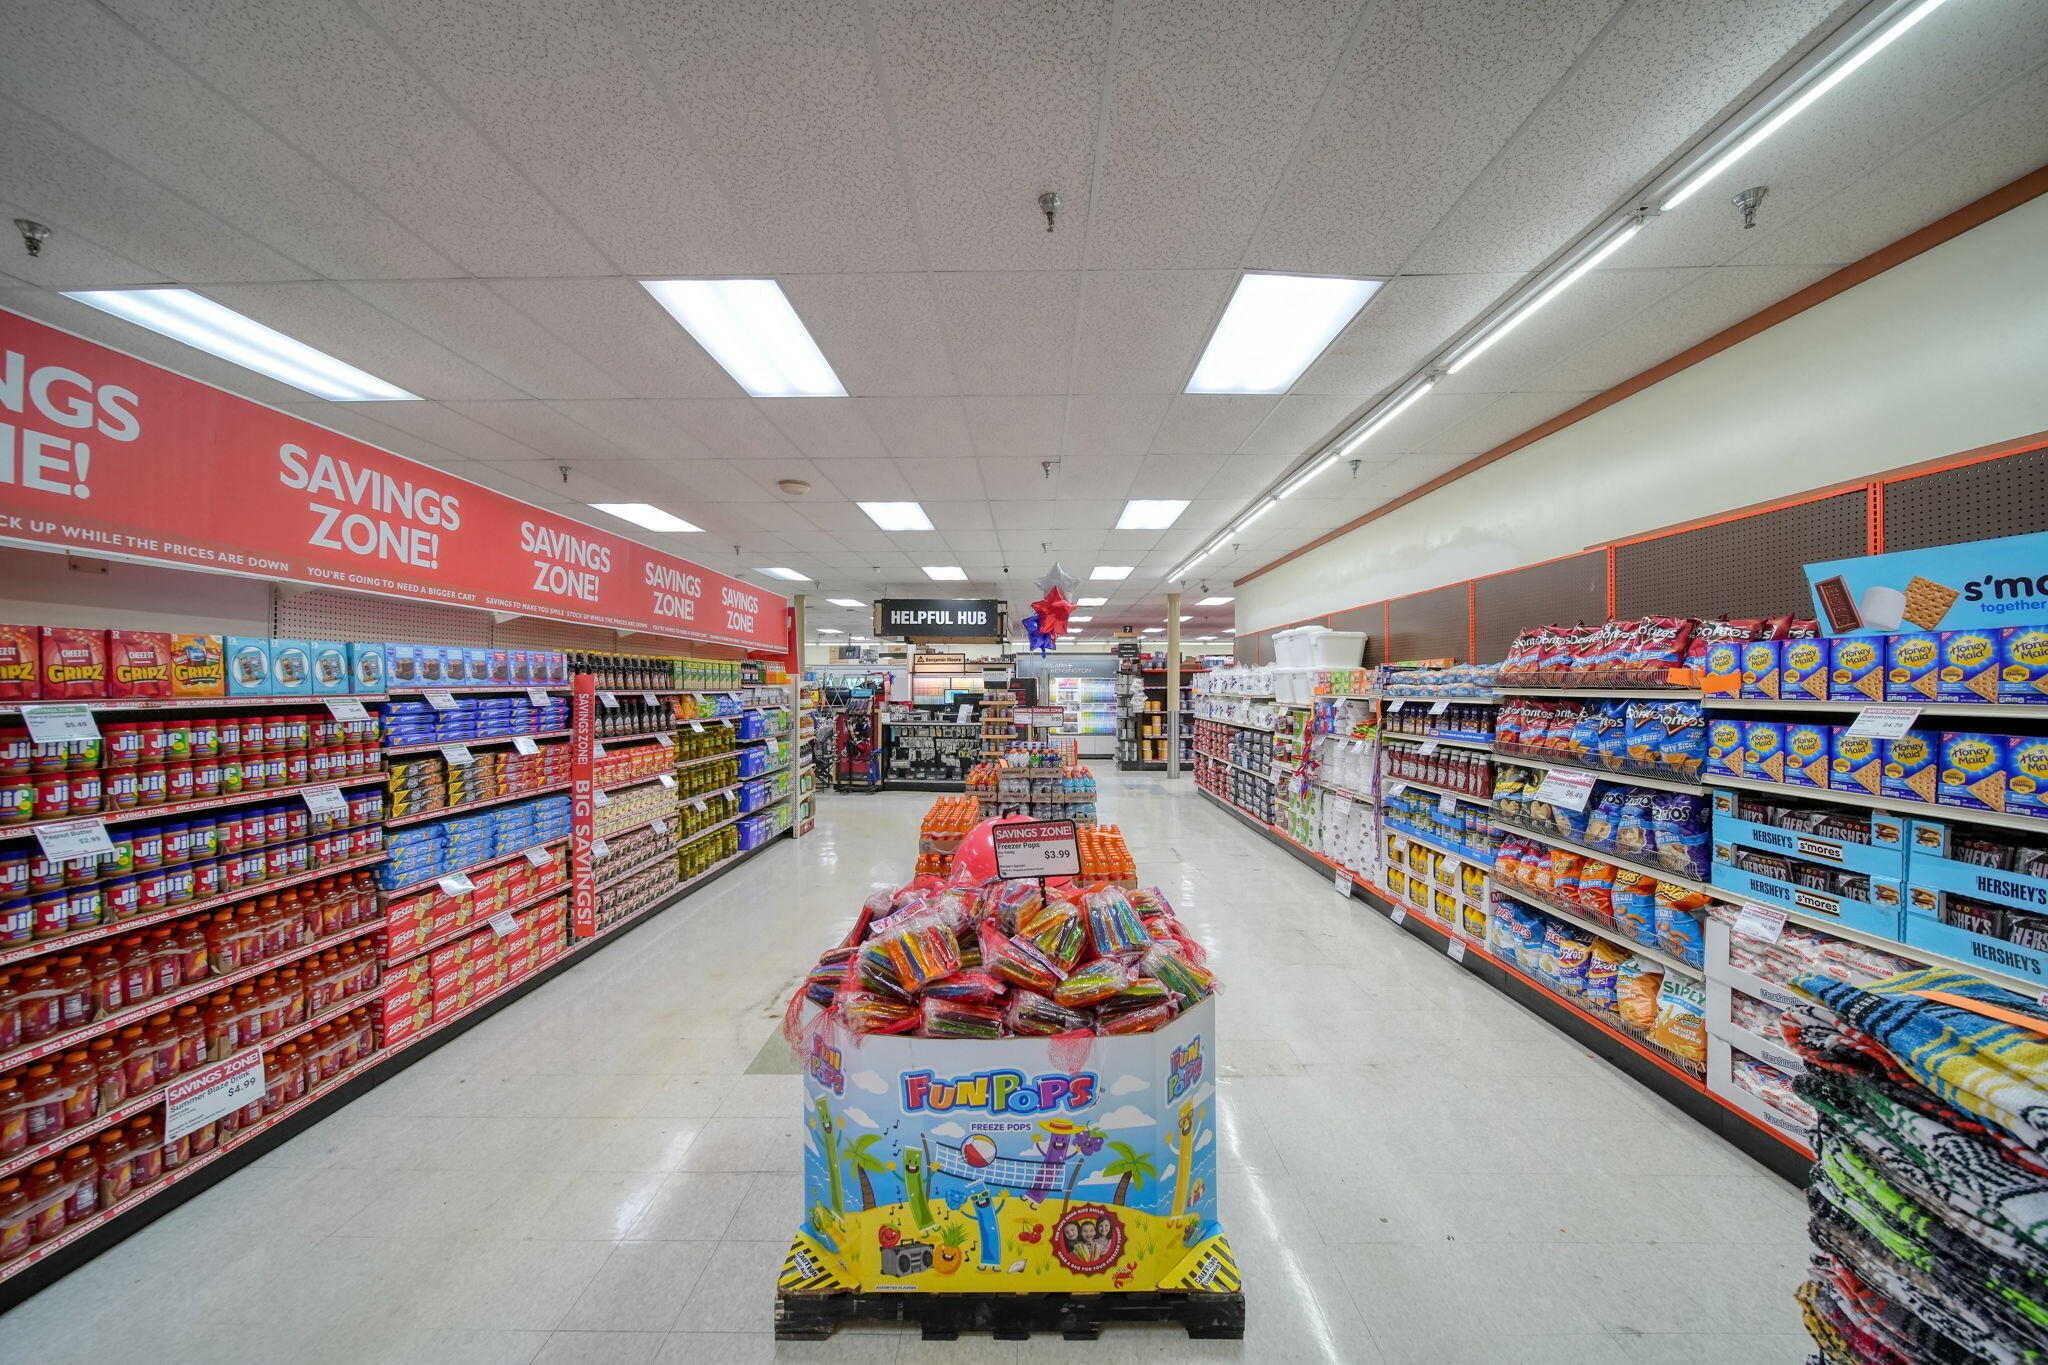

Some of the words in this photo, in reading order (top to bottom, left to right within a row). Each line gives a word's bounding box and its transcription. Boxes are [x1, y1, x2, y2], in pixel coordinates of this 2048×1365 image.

[279, 443, 460, 531] SAVINGS
[308, 502, 439, 570] ZONE!
[30, 519, 57, 535] UP
[61, 525, 122, 546] WHILE
[125, 536, 158, 551] THE
[163, 543, 215, 560] PRICES
[217, 552, 244, 565] ARE
[248, 557, 289, 572] DOWN
[521, 521, 611, 573] SAVINGS
[307, 566, 346, 581] YOU'RE
[349, 574, 381, 587] GOING
[382, 579, 395, 588] TO
[397, 582, 419, 593] NEED
[420, 586, 427, 594] A
[428, 588, 456, 599] BIGGER
[458, 592, 476, 602] CART
[533, 560, 599, 602] ZONE!
[645, 562, 702, 598] SAVINGS
[485, 597, 513, 608] SAVINGS
[513, 601, 521, 609] TO
[522, 603, 538, 612] MAKE
[538, 606, 549, 614] YOU
[550, 607, 564, 616] SMILE
[653, 592, 694, 621] ZONE!
[721, 587, 759, 614] SAVINGS
[1980, 600, 2045, 614] together
[566, 611, 583, 620] STOCK
[727, 610, 754, 633] ZONE!
[890, 610, 953, 625] HELPFUL
[957, 611, 987, 625] HUB
[1790, 649, 1817, 661] Honey
[1898, 645, 1933, 658] Honey
[1950, 641, 1988, 655] Honey
[1956, 650, 1984, 662] Maid
[1712, 653, 1732, 664] Honey
[1714, 659, 1730, 668] Maid
[1794, 656, 1814, 666] Maid
[1903, 652, 1929, 663] Maid
[47, 664, 105, 684] GRIPZ
[117, 665, 169, 684] GRIPZ
[174, 665, 222, 682] GRIPZ
[578, 693, 589, 736] SAVINGS
[1713, 730, 1735, 739] Honey
[1793, 736, 1818, 747] Honey
[578, 735, 588, 764] ZONE!
[1797, 743, 1816, 751] Maid
[1951, 746, 1990, 758] Honey
[1958, 755, 1987, 765] Maid
[575, 780, 590, 816] BIG
[1565, 790, 1584, 799] $6.49
[115, 810, 147, 820] SAVINGS
[42, 831, 69, 840] Peanut
[70, 828, 93, 836] Butter
[996, 828, 1037, 839] SAVINGS
[1040, 826, 1072, 837] ZONE!
[1818, 825, 1871, 845] HERSHEY
[1023, 842, 1040, 850] Pops
[1753, 829, 1793, 849] HERSHEY'S
[1800, 842, 1841, 857] s'mores
[1044, 850, 1070, 859] $3.99
[576, 824, 591, 926] SAVINGS!
[1742, 860, 1787, 881] HERSHEY'S
[475, 876, 493, 891] Zesta
[511, 884, 527, 897] Zesta
[1977, 876, 2047, 905] HERSHEY'S
[1750, 879, 1790, 901] HERSHEY'S
[1797, 894, 1838, 912] s'mores
[389, 904, 414, 923] Zesta
[474, 897, 494, 913] Zesta
[434, 911, 457, 929] Zesta
[44, 940, 63, 950] BIG
[392, 929, 415, 948] Zesta
[433, 949, 455, 967] Zesta
[1972, 941, 2042, 975] HERSHEY'S
[1668, 1028, 1702, 1044] CHEDDAR
[1673, 1024, 1697, 1036] WHITE
[42, 1039, 62, 1052] BIG
[813, 1033, 842, 1070] FUN
[1171, 1038, 1200, 1073] FUN
[169, 1070, 222, 1101] SAVINGS
[224, 1052, 259, 1074] ZONE!
[1168, 1060, 1203, 1103] POPS
[170, 1093, 205, 1113] Summer
[207, 1081, 229, 1095] Blaze
[230, 1070, 251, 1084] Drink
[228, 1077, 256, 1097] $4.99
[971, 1123, 1005, 1131] FREEZE
[1007, 1123, 1031, 1131] POPS
[49, 1136, 68, 1151] BIG
[40, 1238, 60, 1255] BIG
[795, 1250, 819, 1278] CAUTION
[1194, 1256, 1218, 1283] CAUTION
